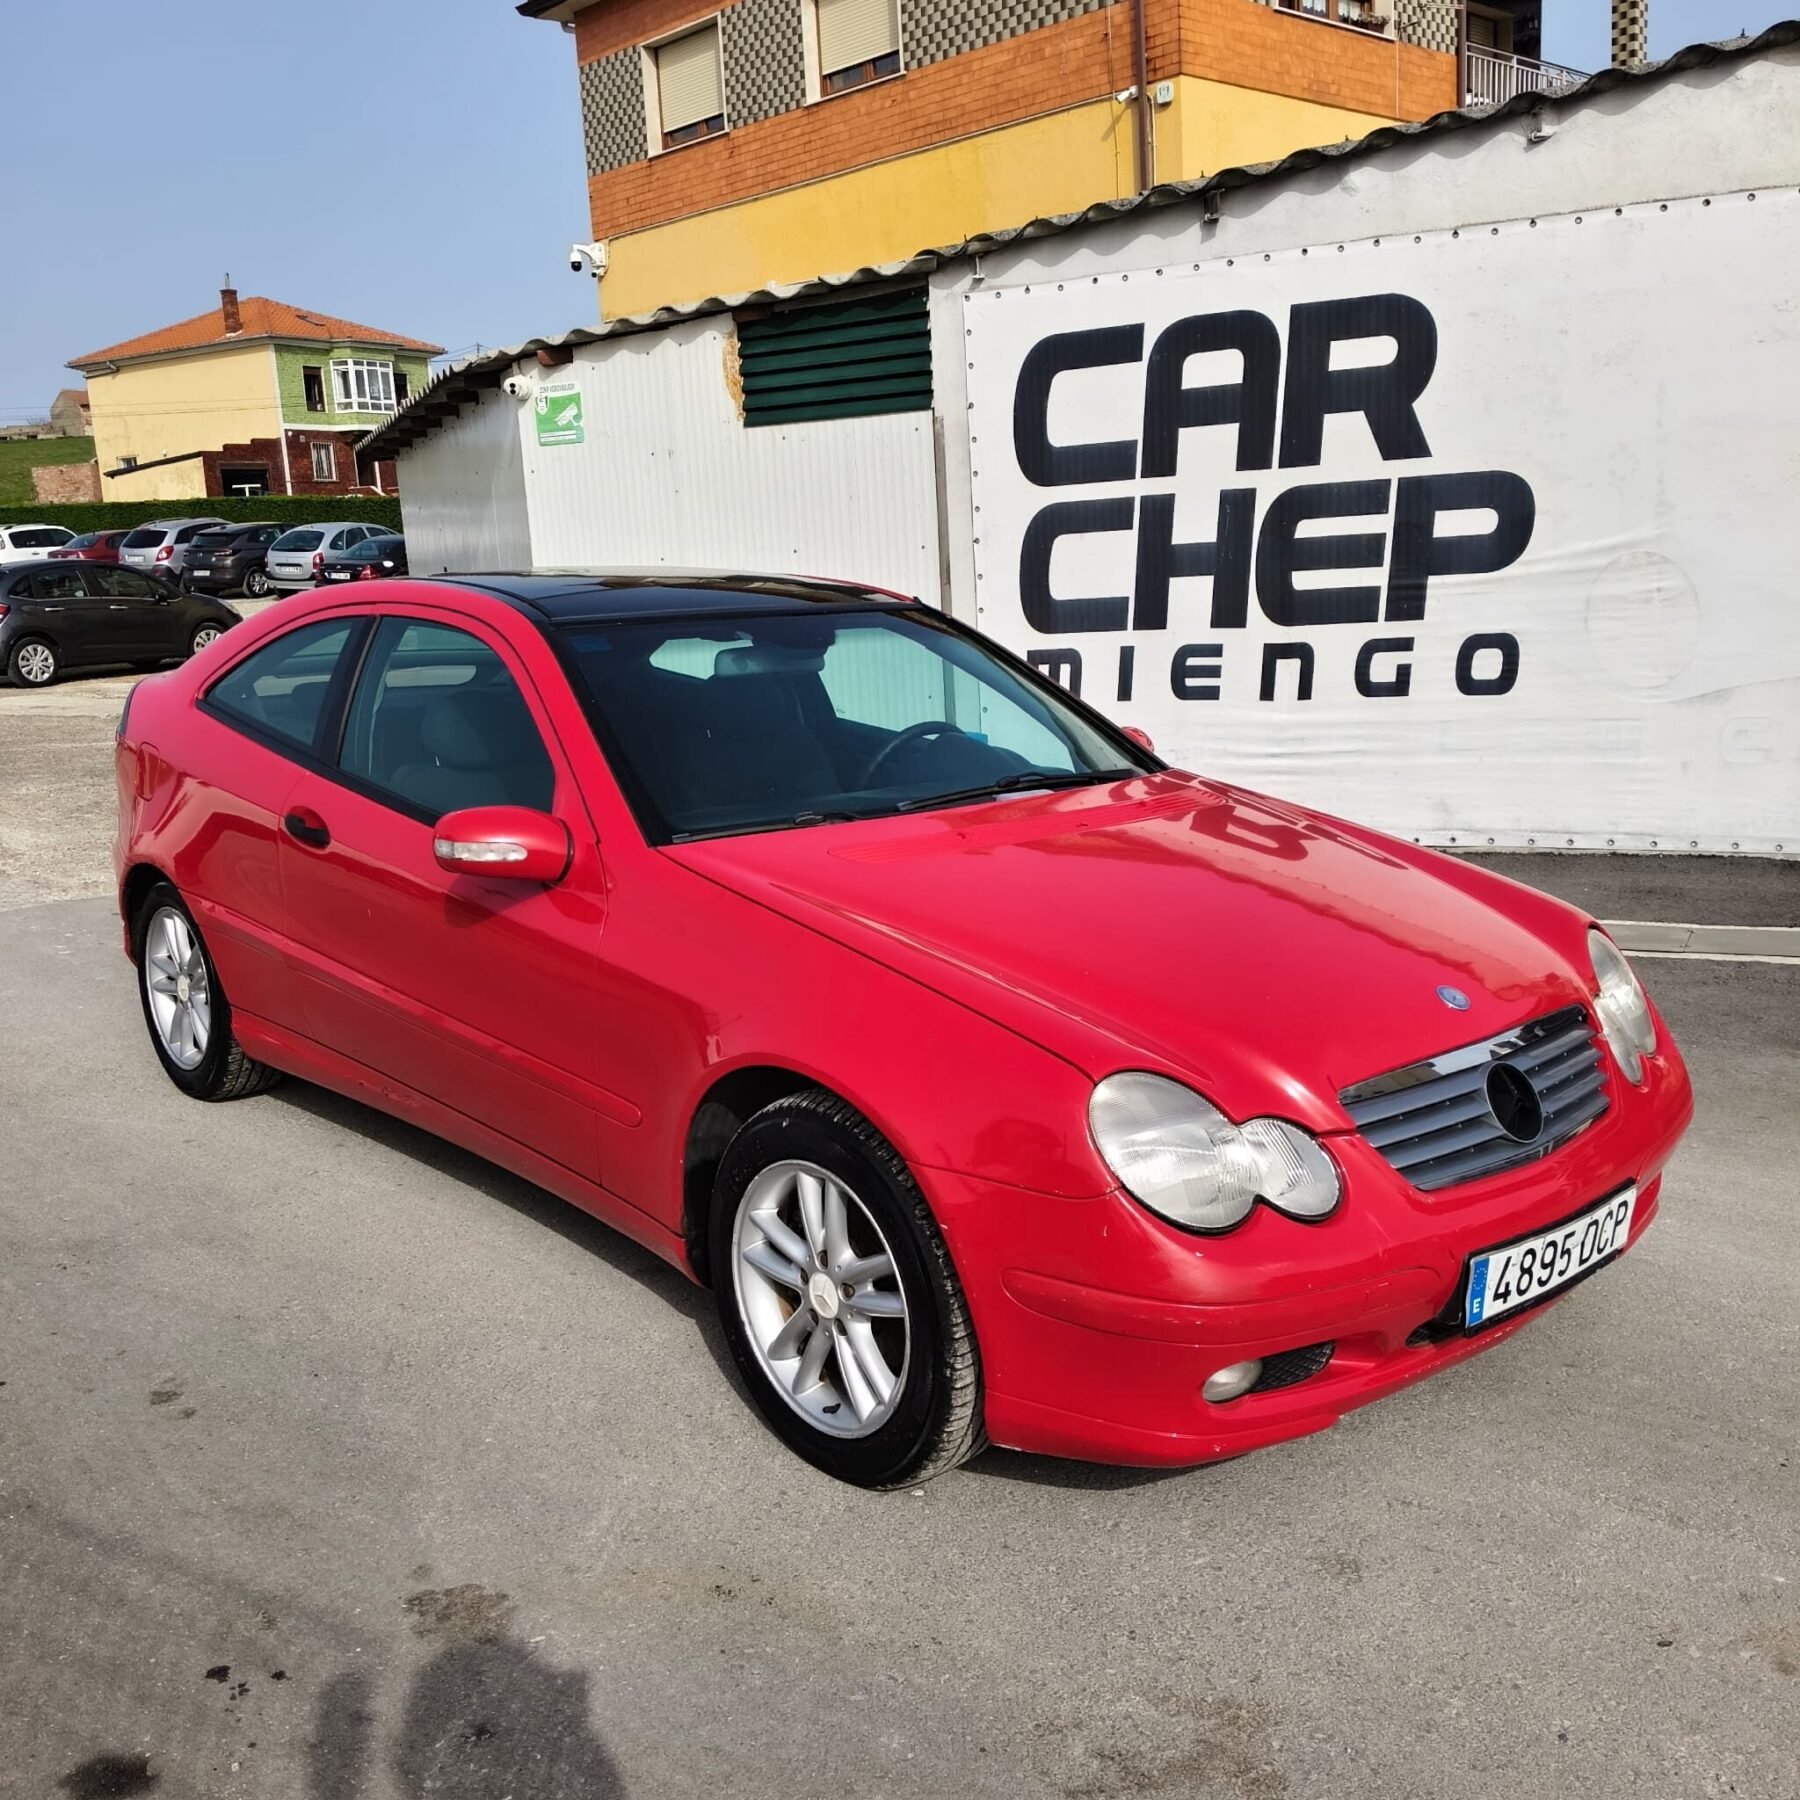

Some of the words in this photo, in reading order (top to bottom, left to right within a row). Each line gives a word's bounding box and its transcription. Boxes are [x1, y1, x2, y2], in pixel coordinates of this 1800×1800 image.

[1013, 293, 1437, 487] CAR
[1020, 470, 1535, 634] CHEP
[1027, 633, 1520, 702] MIENGO
[1472, 1298, 1481, 1314] E
